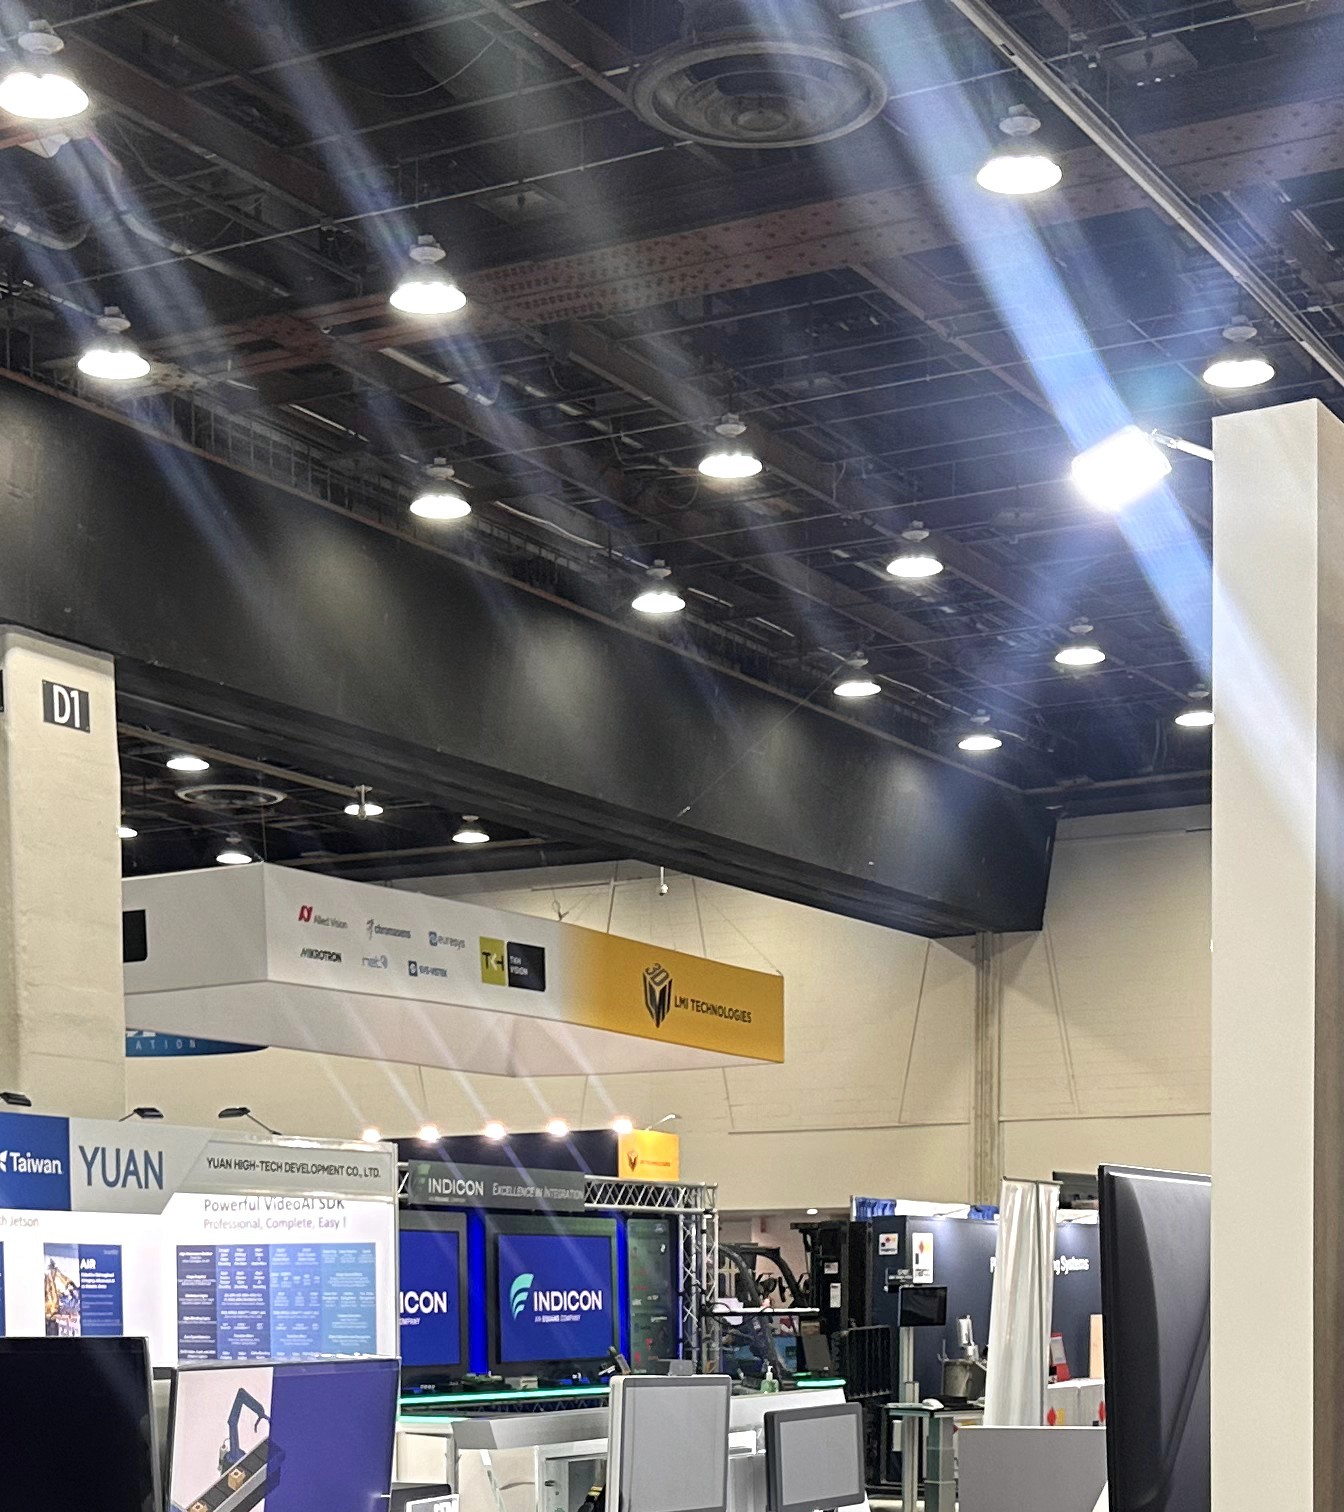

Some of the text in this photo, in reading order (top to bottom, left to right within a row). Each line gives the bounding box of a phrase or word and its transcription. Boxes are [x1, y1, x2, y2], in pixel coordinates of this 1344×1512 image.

[52, 684, 81, 729] D1
[690, 998, 752, 1023] TECHNOLOGIES
[9, 1151, 63, 1175] Taiwan
[78, 1145, 164, 1190] YUAN
[206, 1156, 232, 1170] YUAN
[233, 1158, 283, 1173] HIGH-TECH
[284, 1161, 344, 1177] DEVELOPMENT
[428, 1177, 485, 1197] INDICON
[204, 1197, 260, 1213] Powerful
[399, 1289, 447, 1314] ICON
[533, 1290, 603, 1311] INDICON
